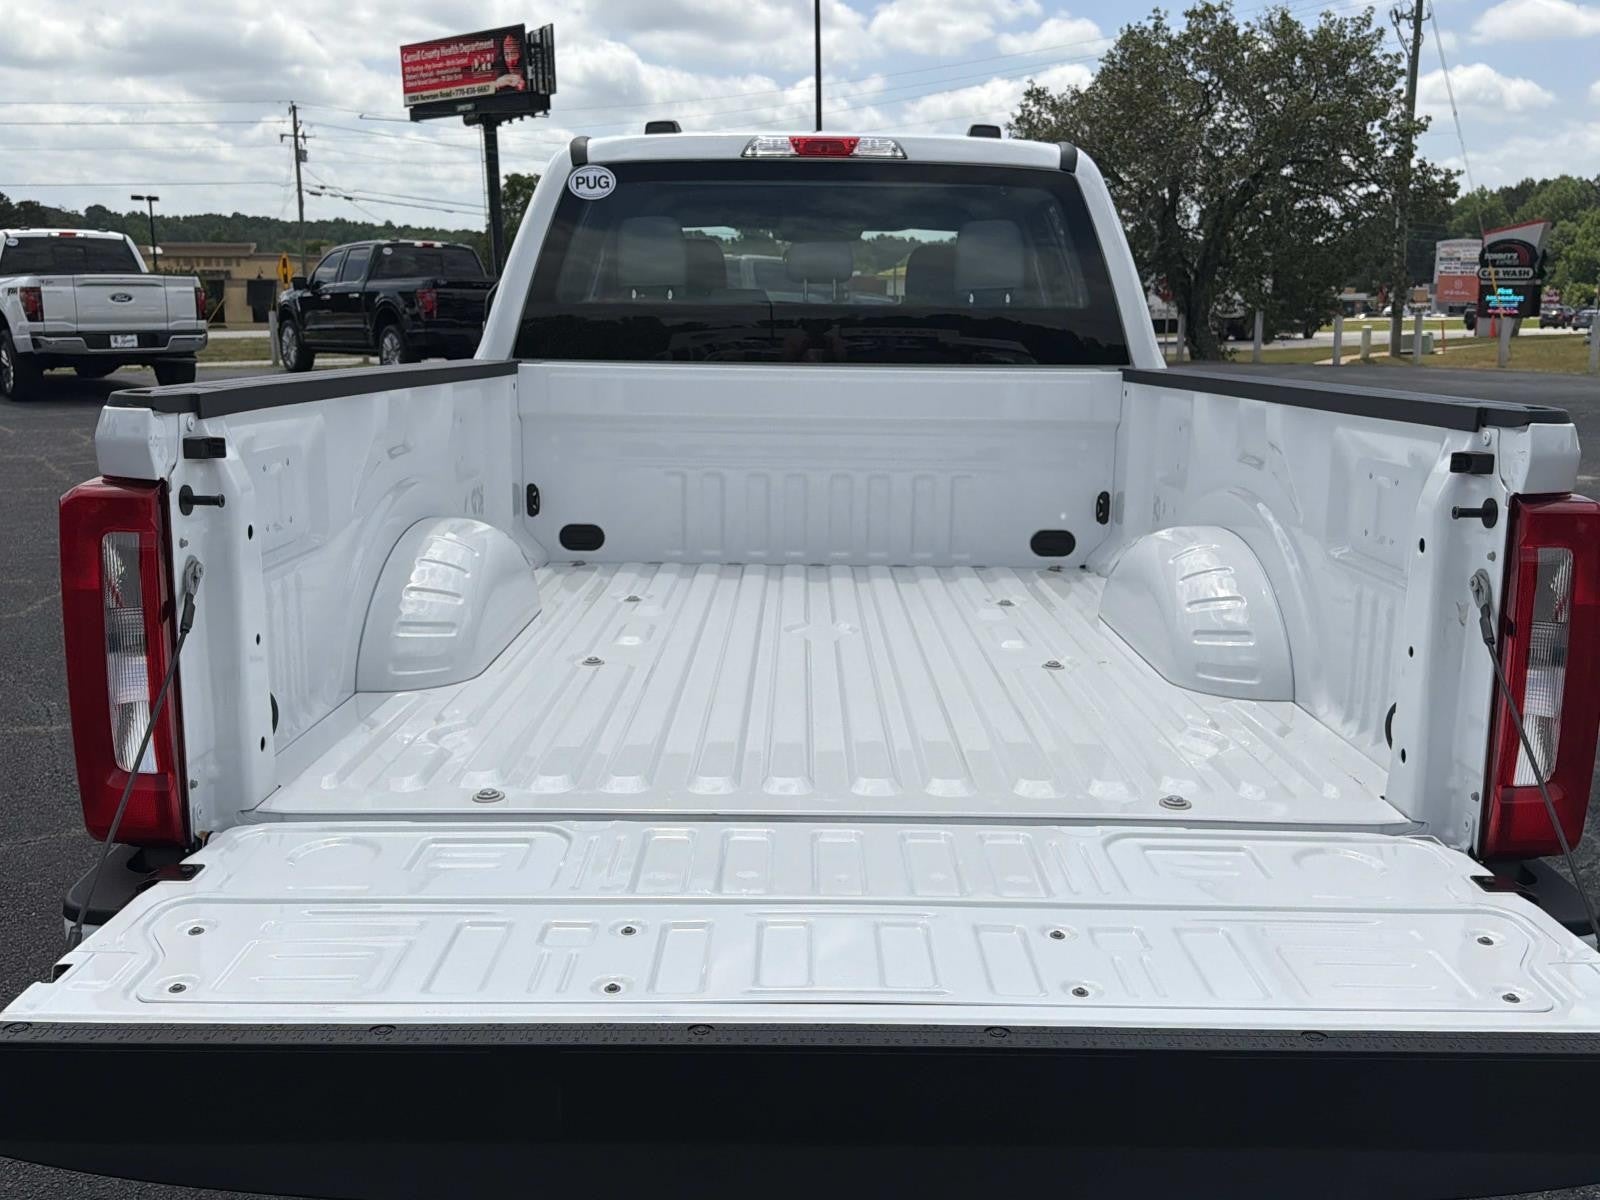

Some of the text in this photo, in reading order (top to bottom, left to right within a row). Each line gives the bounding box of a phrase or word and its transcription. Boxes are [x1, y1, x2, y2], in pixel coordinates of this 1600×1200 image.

[403, 38, 494, 63] Carroll County Health Department
[576, 175, 610, 190] PUG
